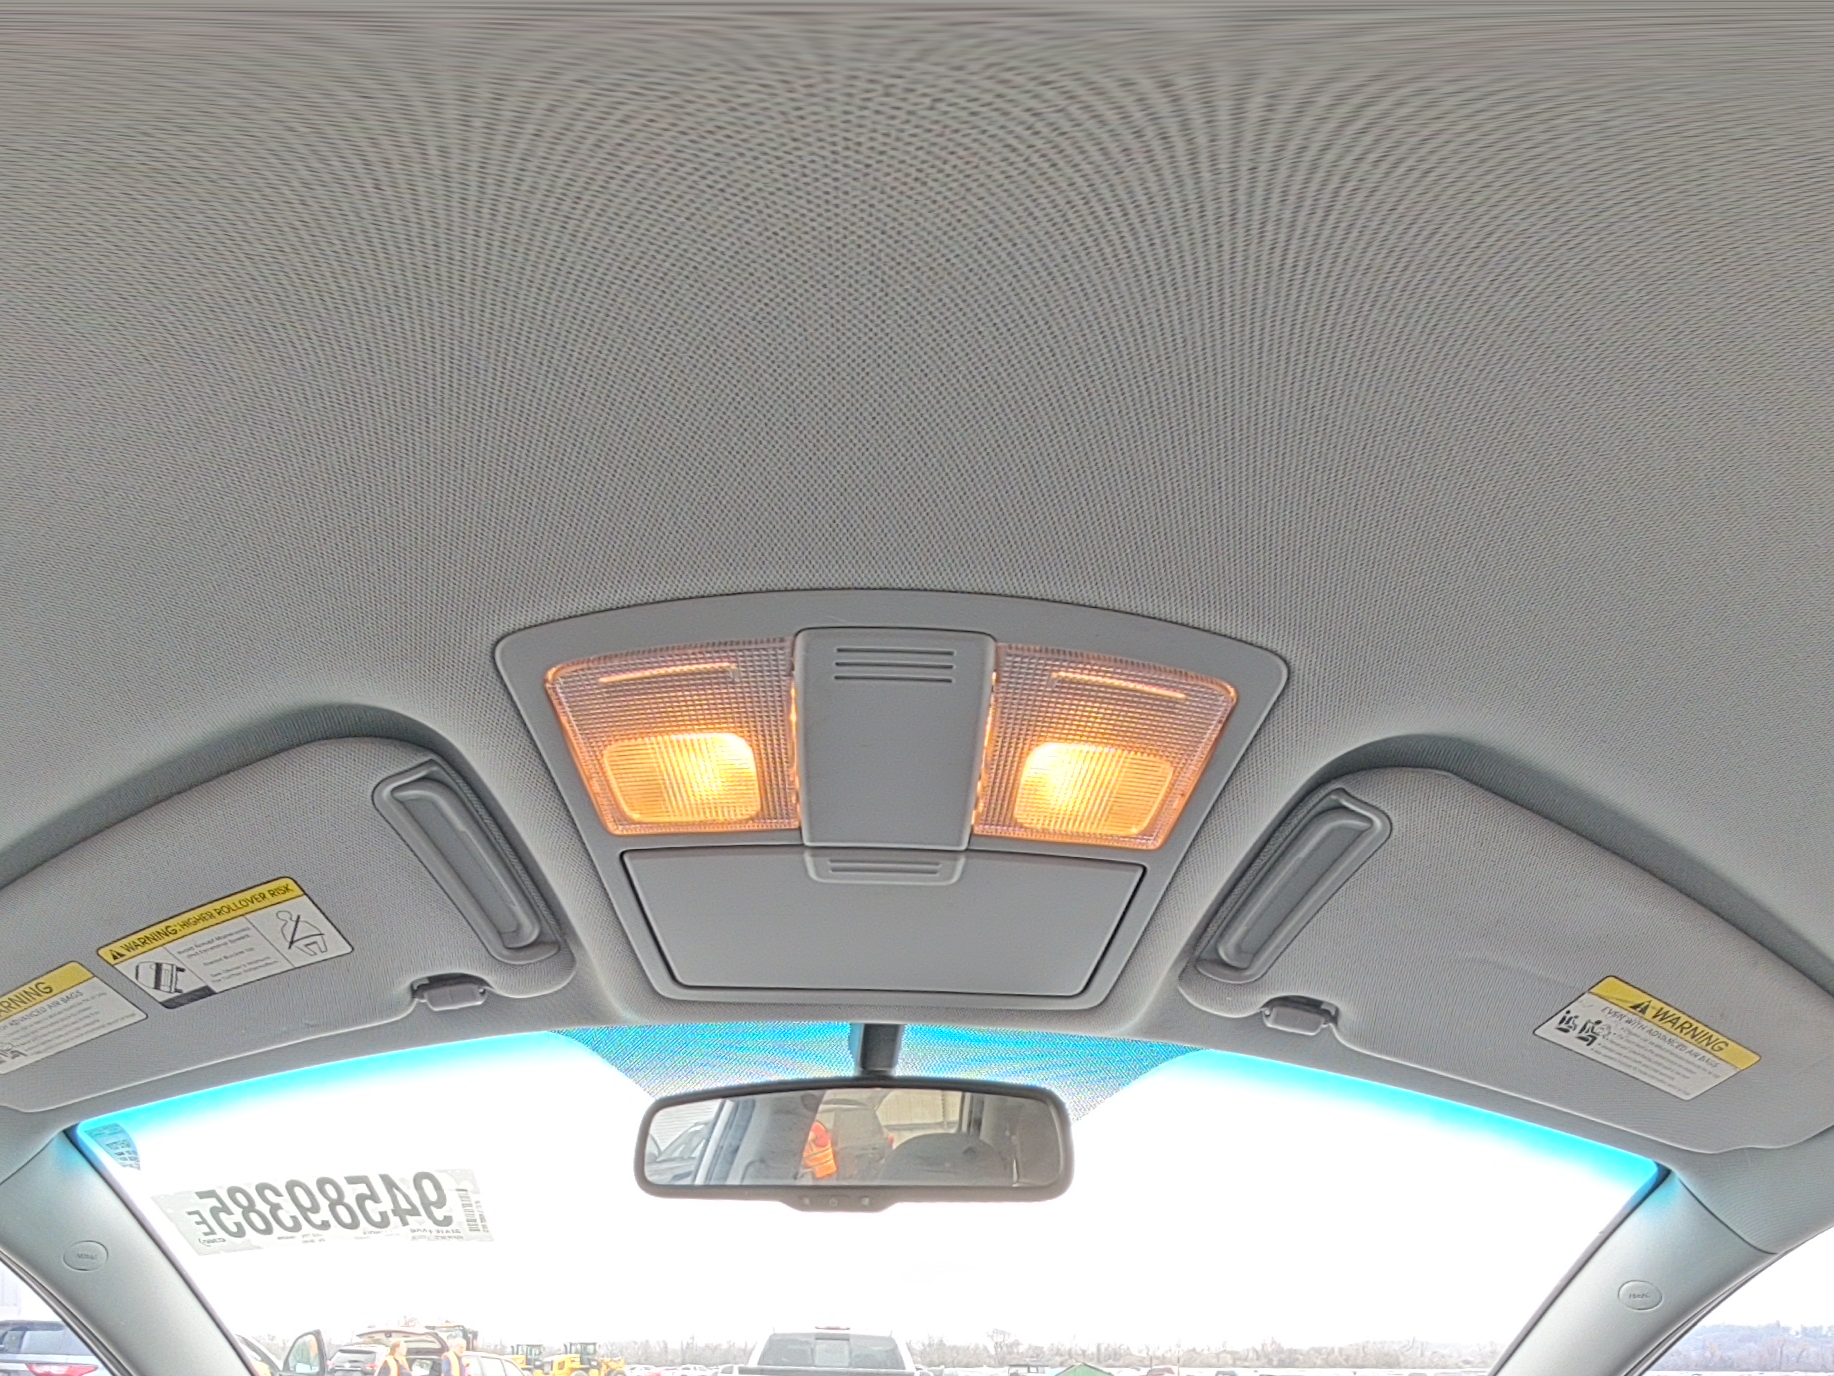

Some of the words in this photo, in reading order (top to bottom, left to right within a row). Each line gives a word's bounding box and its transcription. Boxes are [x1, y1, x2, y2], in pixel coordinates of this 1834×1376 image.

[179, 910, 216, 933] HIGHER
[214, 891, 267, 921] ROLLOVER
[268, 883, 293, 899] RISK
[9, 1006, 47, 1027] ADVANCED
[47, 1000, 61, 1011] AIR
[62, 989, 84, 1004] BAGS
[1652, 1006, 1729, 1053] WARNING
[1601, 1006, 1626, 1022] EVEN
[1625, 1016, 1646, 1031] WITH
[1647, 1026, 1688, 1051] ADVANCED
[1698, 1054, 1721, 1068] BAGS
